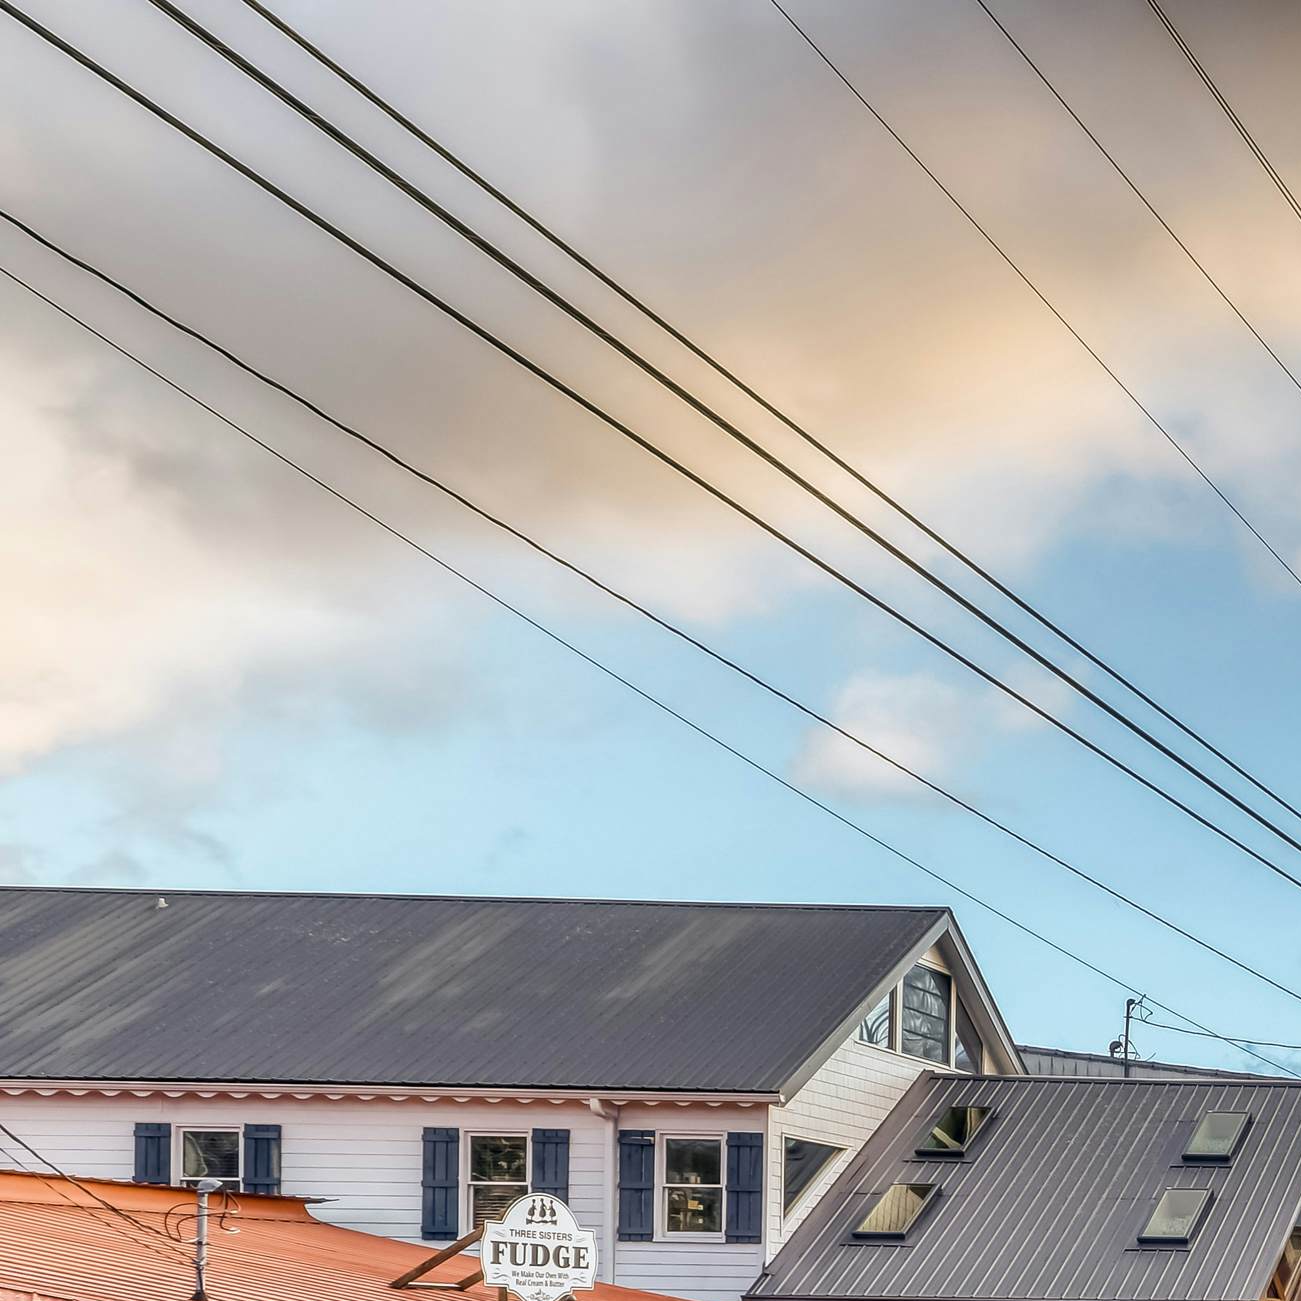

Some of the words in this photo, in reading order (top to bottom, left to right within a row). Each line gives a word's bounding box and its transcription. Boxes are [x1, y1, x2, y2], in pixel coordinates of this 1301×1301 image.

[510, 1229, 537, 1239] THREE
[538, 1231, 573, 1241] SISTERS
[490, 1240, 589, 1269] FUDGE
